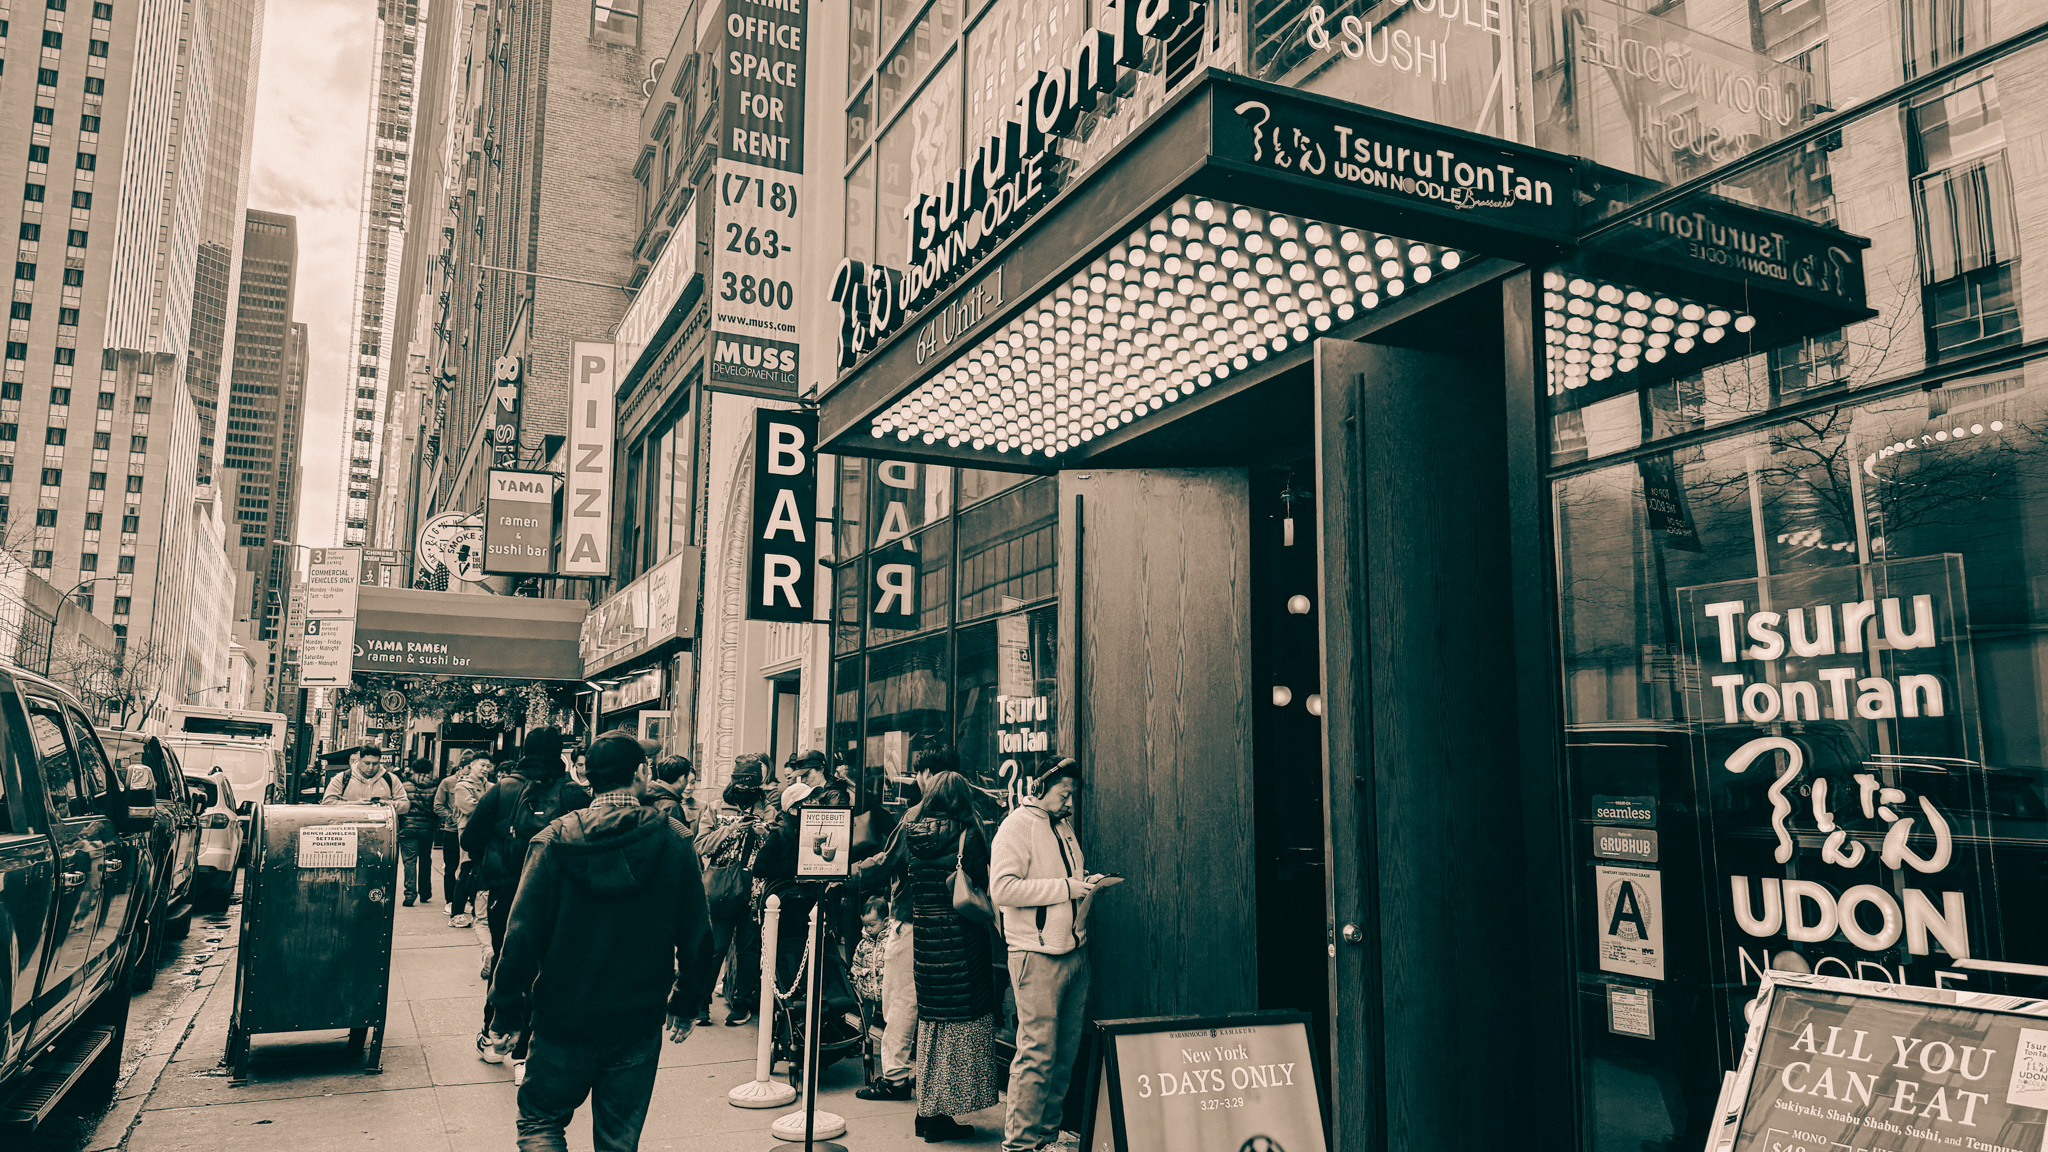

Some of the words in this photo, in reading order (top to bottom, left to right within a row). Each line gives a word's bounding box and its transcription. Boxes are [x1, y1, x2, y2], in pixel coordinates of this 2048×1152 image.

[728, 13, 801, 51] OFFICE
[1307, 5, 1331, 53] &
[1341, 15, 1447, 84] SUSHI
[730, 51, 797, 87] SPACE
[740, 90, 784, 123] FOR
[732, 127, 790, 161] RENT
[1334, 125, 1553, 206] TsuruTonTan
[722, 173, 797, 218] (718)
[1334, 161, 1388, 188] UDON
[1390, 173, 1462, 205] NOODLE
[726, 223, 791, 259] 263-
[899, 231, 957, 310] UDON
[953, 149, 1045, 265] NOODLE
[720, 271, 793, 310] 3800
[717, 312, 796, 333] www.muss.com
[915, 323, 938, 365] 64
[942, 265, 1005, 346] Unit-1
[713, 340, 796, 372] MUSS
[713, 362, 779, 381] DEVELOPMENT
[781, 370, 796, 384] LLC
[569, 355, 607, 563] PIZZA
[497, 479, 544, 494] YAMA
[499, 516, 538, 528] ramen
[763, 422, 806, 608] BAR
[314, 551, 323, 563] 3
[448, 533, 475, 554] SMOKE
[489, 543, 522, 556] sushi
[527, 544, 547, 557] bar
[311, 576, 338, 584] VEHICLES
[308, 621, 317, 634] 6
[1705, 594, 1936, 663] Tsuru
[367, 640, 403, 652] YAMA
[407, 642, 448, 654] RAMEN
[368, 653, 402, 663] ramen
[407, 653, 415, 663] &
[420, 655, 448, 665] sushi
[453, 656, 471, 666] bar
[997, 695, 1047, 724] Tsuru
[1711, 668, 1944, 723] TonTan
[997, 727, 1048, 753] TonTan
[1597, 807, 1651, 820] seamless
[1600, 837, 1651, 854] GRUBHUB
[1608, 880, 1649, 940] A
[1731, 875, 1970, 960] UDON
[1182, 1048, 1211, 1064] New
[1215, 1044, 1249, 1062] York
[1790, 1022, 1873, 1063] ALL
[1892, 1035, 1997, 1081] YOU
[1138, 1074, 1152, 1098] 3
[1158, 1068, 1226, 1097] DAYS
[1231, 1063, 1295, 1090] ONLY
[2020, 1071, 2048, 1081] UDON
[1200, 1097, 1244, 1111] 3.27-3.29
[1782, 1062, 1880, 1107] CAN
[1889, 1080, 1989, 1127] EAT
[1775, 1098, 1824, 1119] Sukiyaki,
[1826, 1109, 1860, 1126] Shabu
[1864, 1116, 1902, 1136] Shabu,
[1905, 1125, 1942, 1143] Sushi,
[1944, 1134, 1962, 1146] and
[1791, 1129, 1827, 1145] MONO
